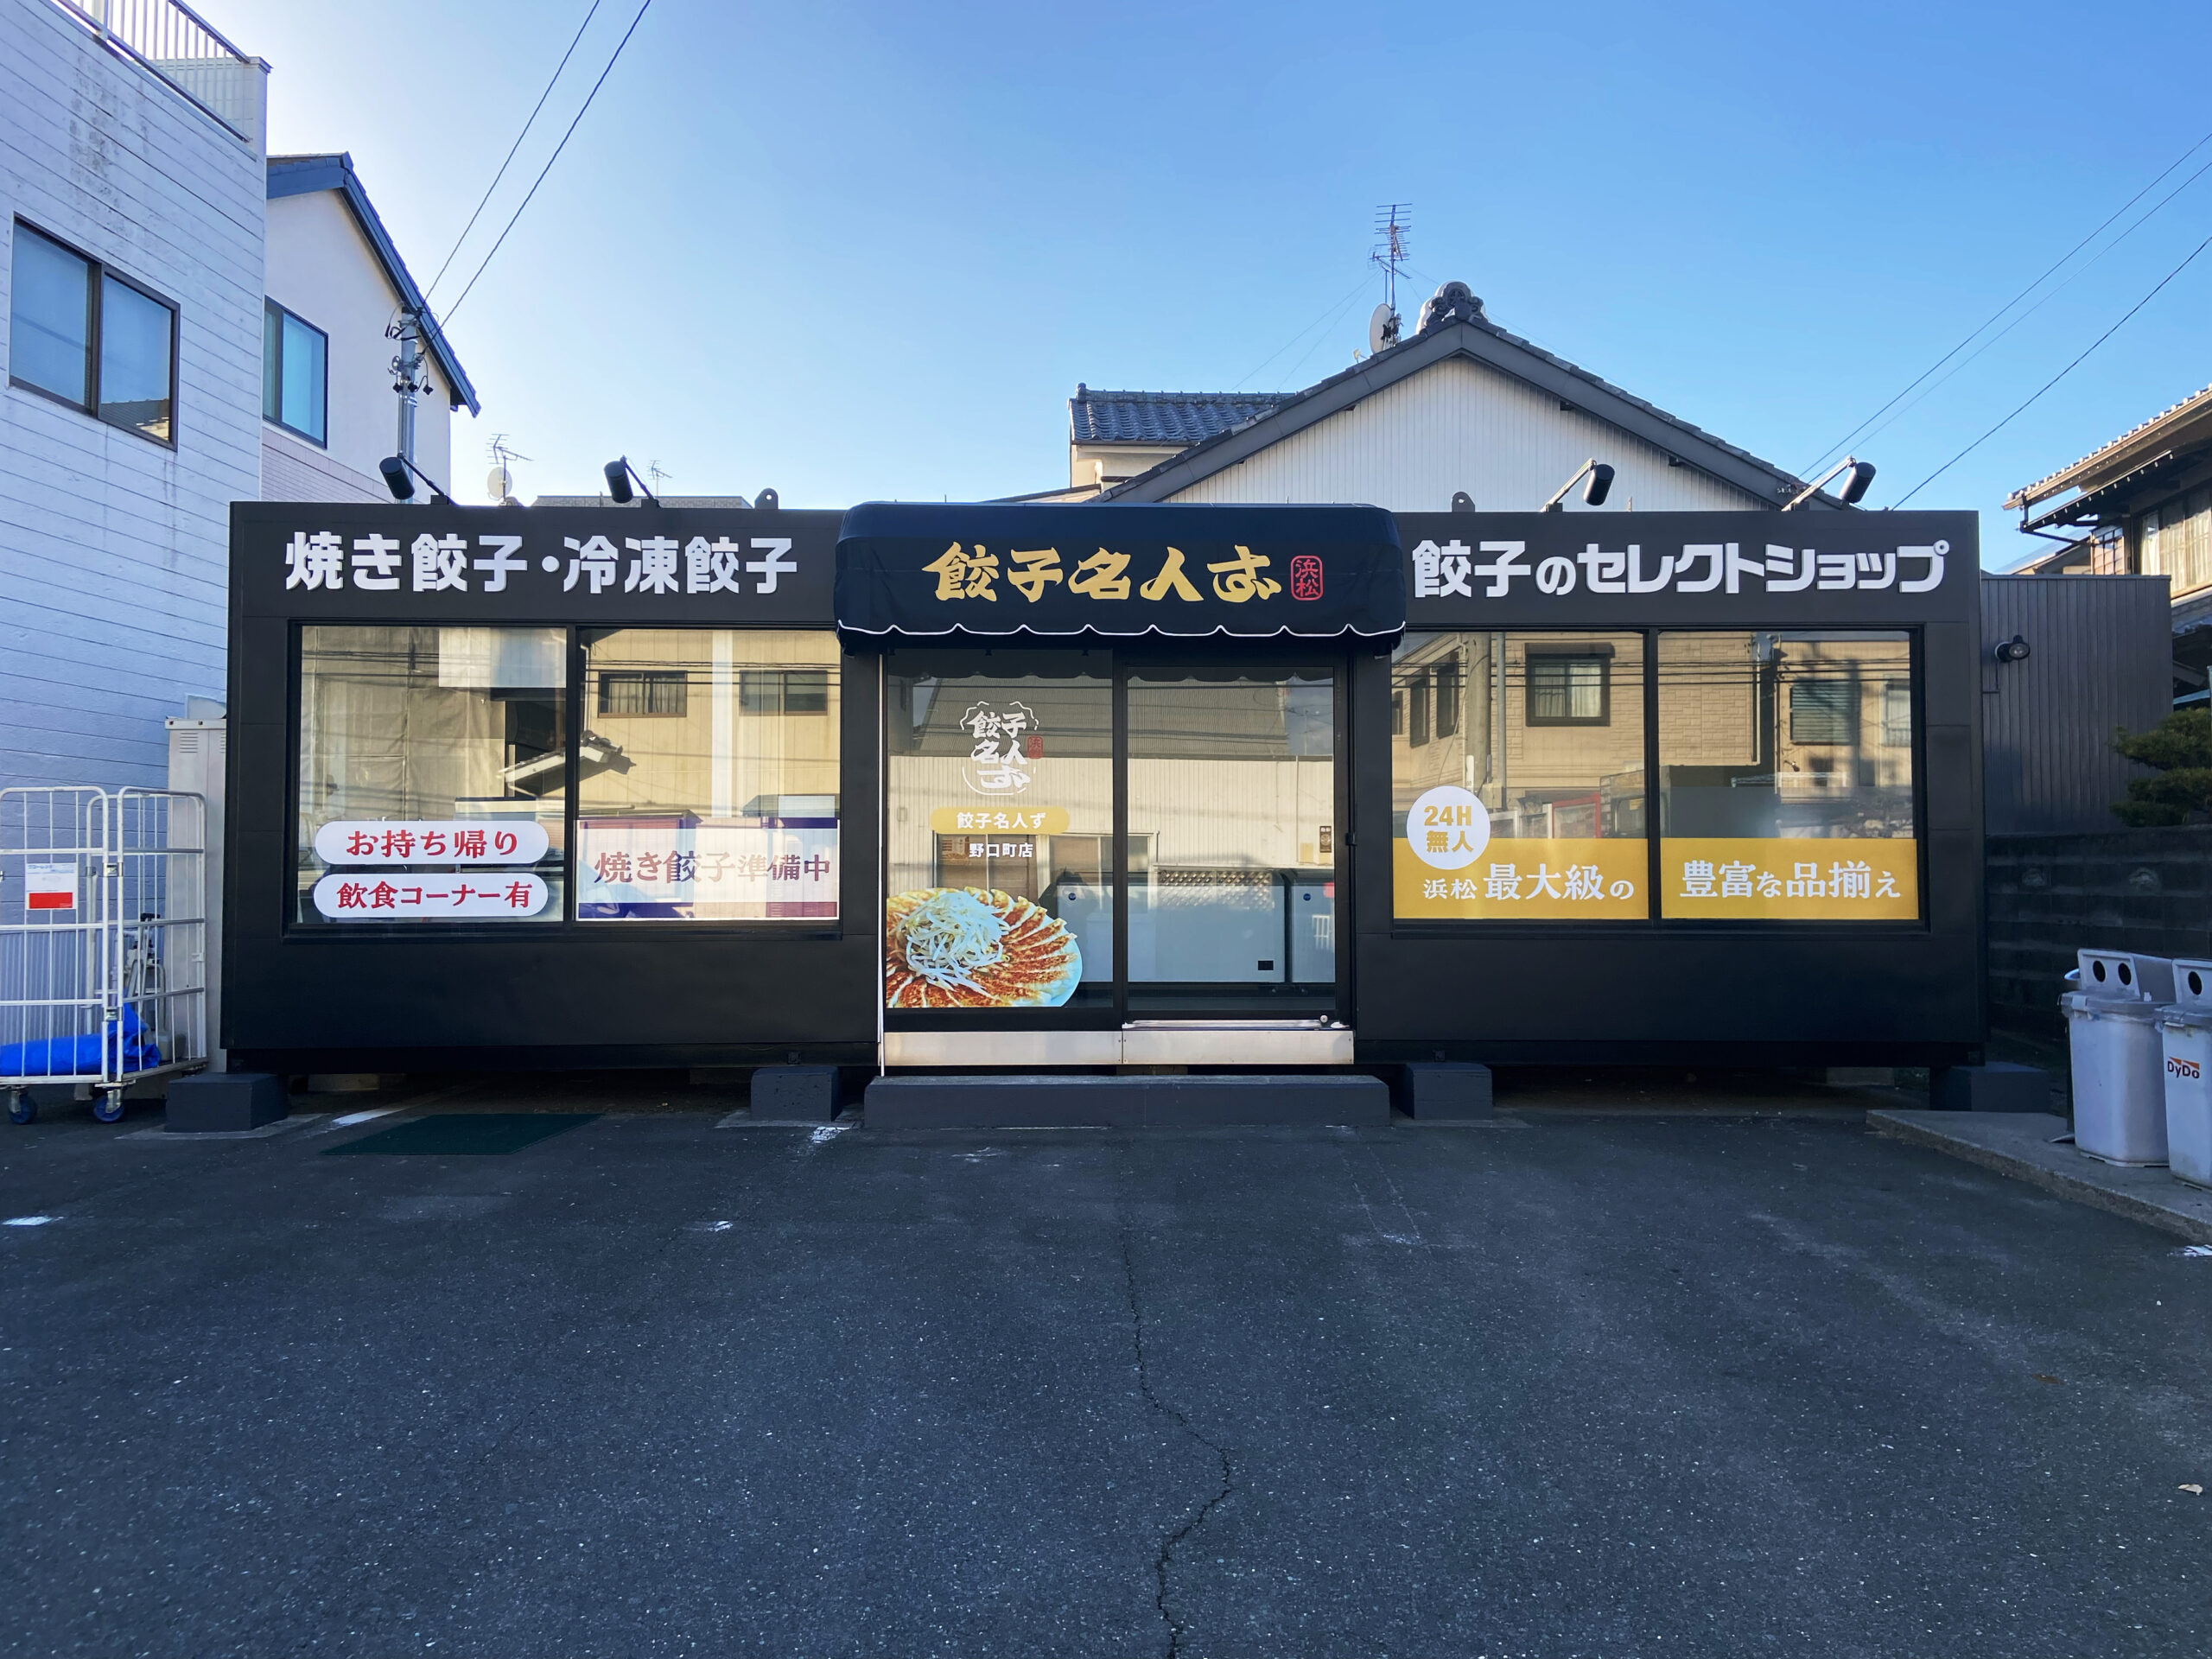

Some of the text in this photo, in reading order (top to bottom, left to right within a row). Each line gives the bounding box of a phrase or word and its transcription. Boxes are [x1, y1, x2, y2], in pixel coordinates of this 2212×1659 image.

[285, 531, 798, 594] 焼き餃子・冷凍餃子
[1412, 539, 1950, 598] 餃子のセレクトショップ
[1294, 559, 1319, 598] 浜松
[967, 710, 1027, 740] 餃子
[970, 739, 1028, 765] 名人
[956, 811, 1046, 830] 餃子名人ず
[1424, 805, 1472, 827] 24H
[346, 830, 518, 858] お持ち帰り
[968, 842, 1034, 859] 野口町店
[1426, 830, 1474, 854] 無人
[594, 851, 830, 883] 焼き餃子準備中
[1679, 860, 1901, 899] 豊富な品揃え
[337, 880, 532, 909] 飲食コーナー有
[2167, 1060, 2200, 1079] DyDo
